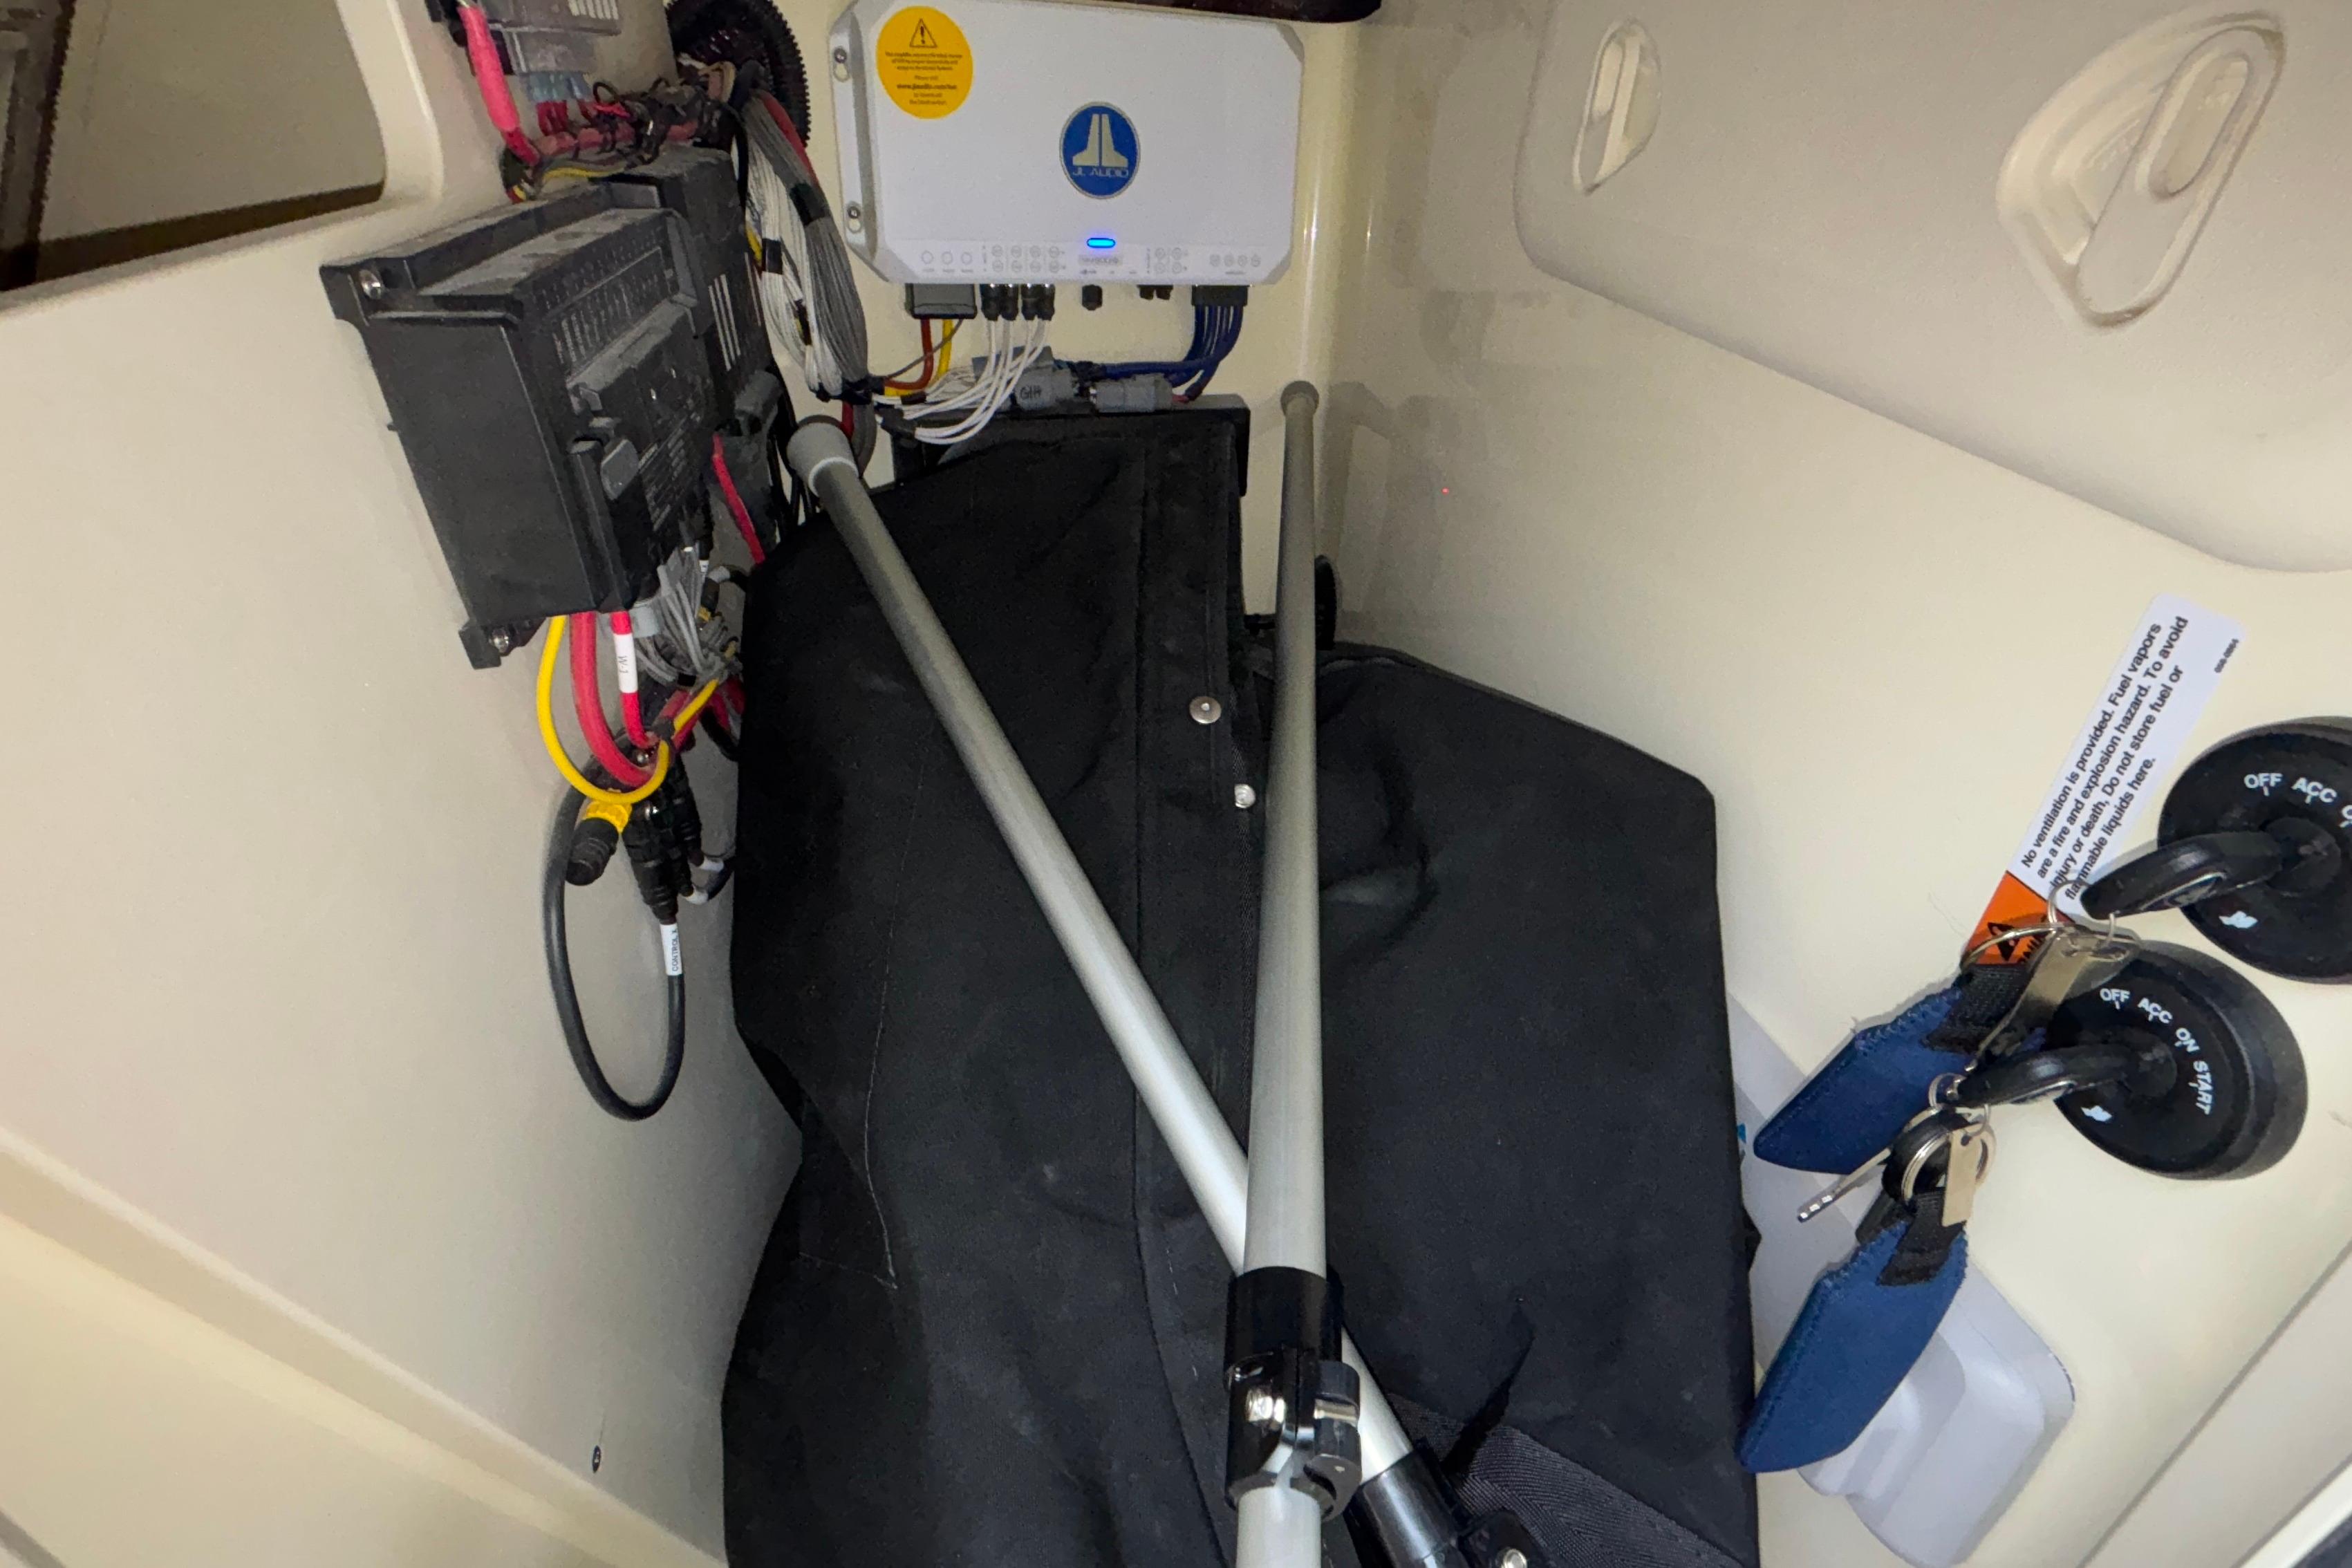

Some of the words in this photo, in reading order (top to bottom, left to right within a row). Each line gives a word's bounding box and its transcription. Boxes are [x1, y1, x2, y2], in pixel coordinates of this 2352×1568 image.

[2158, 616, 2189, 660] avoid
[2143, 661, 2163, 679] To
[2113, 684, 2152, 734] hazard.
[2021, 849, 2037, 868] No
[2033, 785, 2072, 848] ventilation
[2065, 771, 2080, 785] is
[2075, 709, 2115, 772] provided.
[2107, 673, 2133, 707] Fuel
[2127, 624, 2162, 673] vapors
[2072, 837, 2084, 853] or
[2101, 776, 2120, 797] Do
[2116, 751, 2135, 776] not
[2129, 714, 2156, 751] store
[2149, 683, 2174, 713] fuel
[2169, 665, 2183, 683] or
[2080, 735, 2122, 800] explosion
[2101, 792, 2134, 837] liquids
[2127, 758, 2156, 791] here.
[2243, 772, 2284, 789] OFF
[2290, 776, 2337, 803] ACC
[2066, 798, 2085, 825] and
[2048, 848, 2059, 858] a
[2052, 825, 2071, 848] fire
[2037, 857, 2053, 879] are
[2099, 987, 2131, 1002] OFF
[2136, 997, 2174, 1024] ACC
[2175, 1027, 2201, 1053] ON
[2192, 1060, 2214, 1116] START
